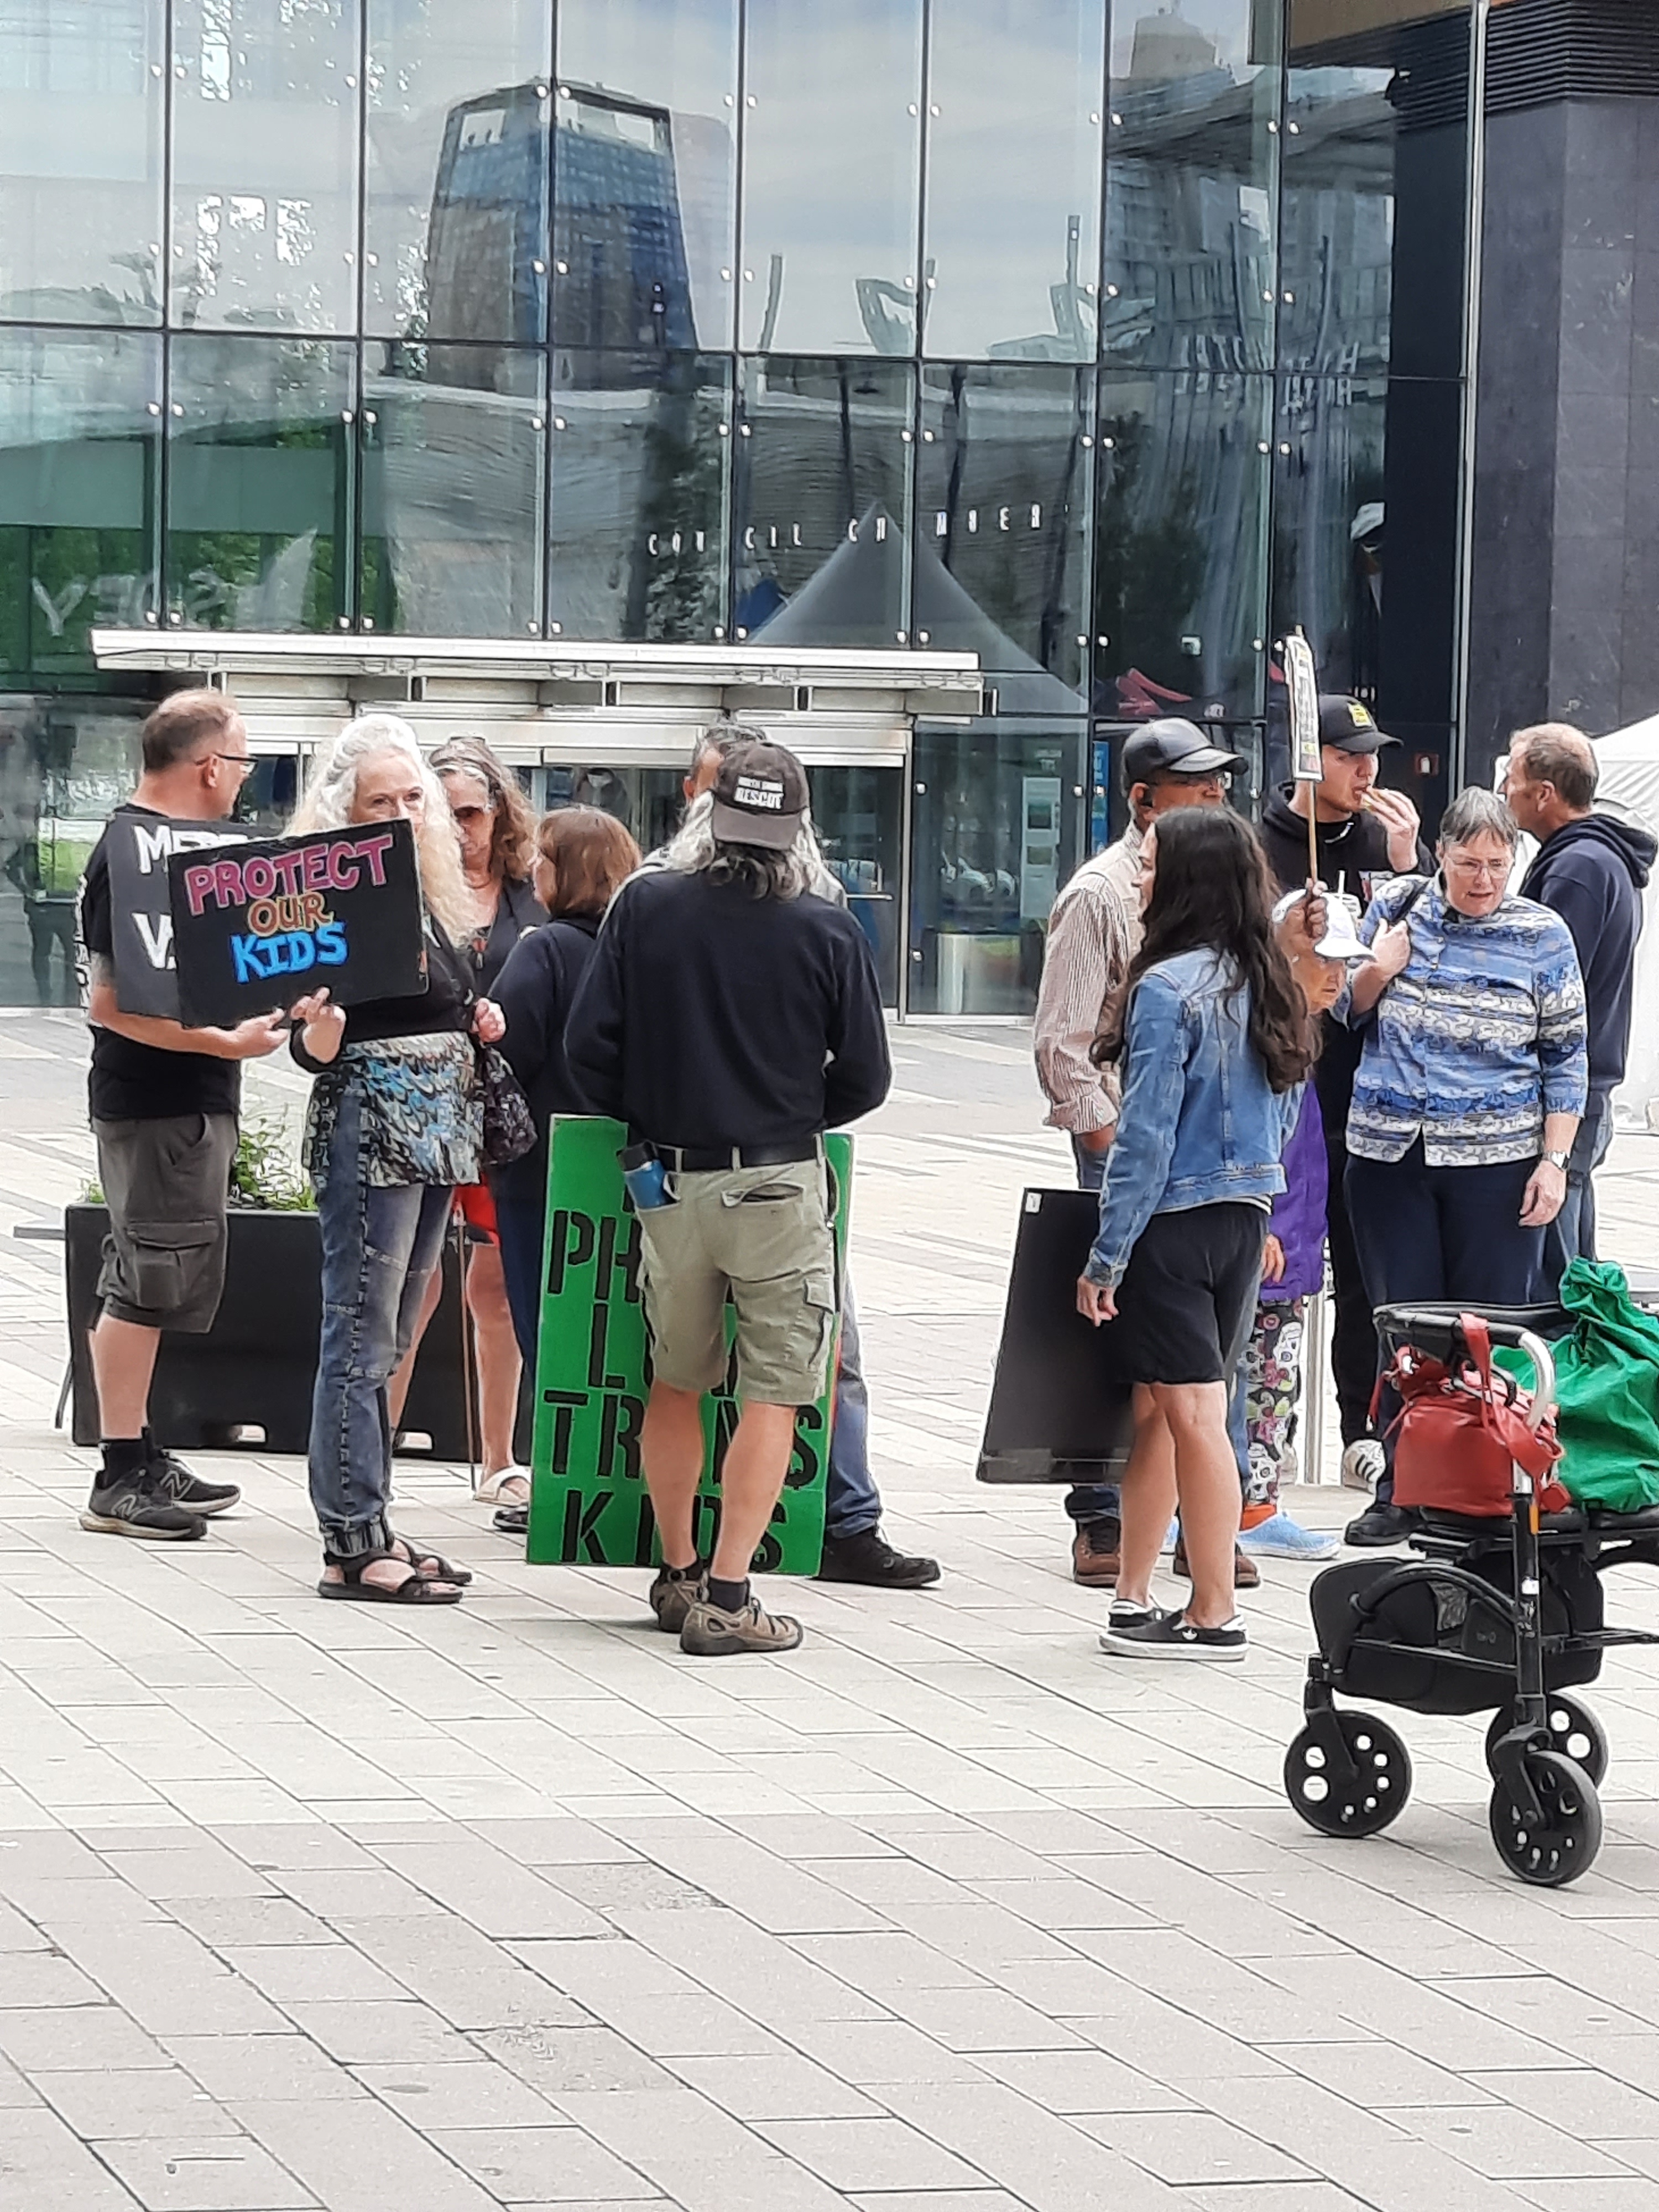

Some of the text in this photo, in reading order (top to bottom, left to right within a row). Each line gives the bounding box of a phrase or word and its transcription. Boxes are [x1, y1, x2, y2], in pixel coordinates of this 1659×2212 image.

[649, 504, 1041, 555] COUCIL CHMBER
[185, 833, 393, 916] PROTECT
[248, 891, 335, 937] OUR
[230, 920, 348, 983] KIDS
[544, 1389, 822, 1490] TRNS
